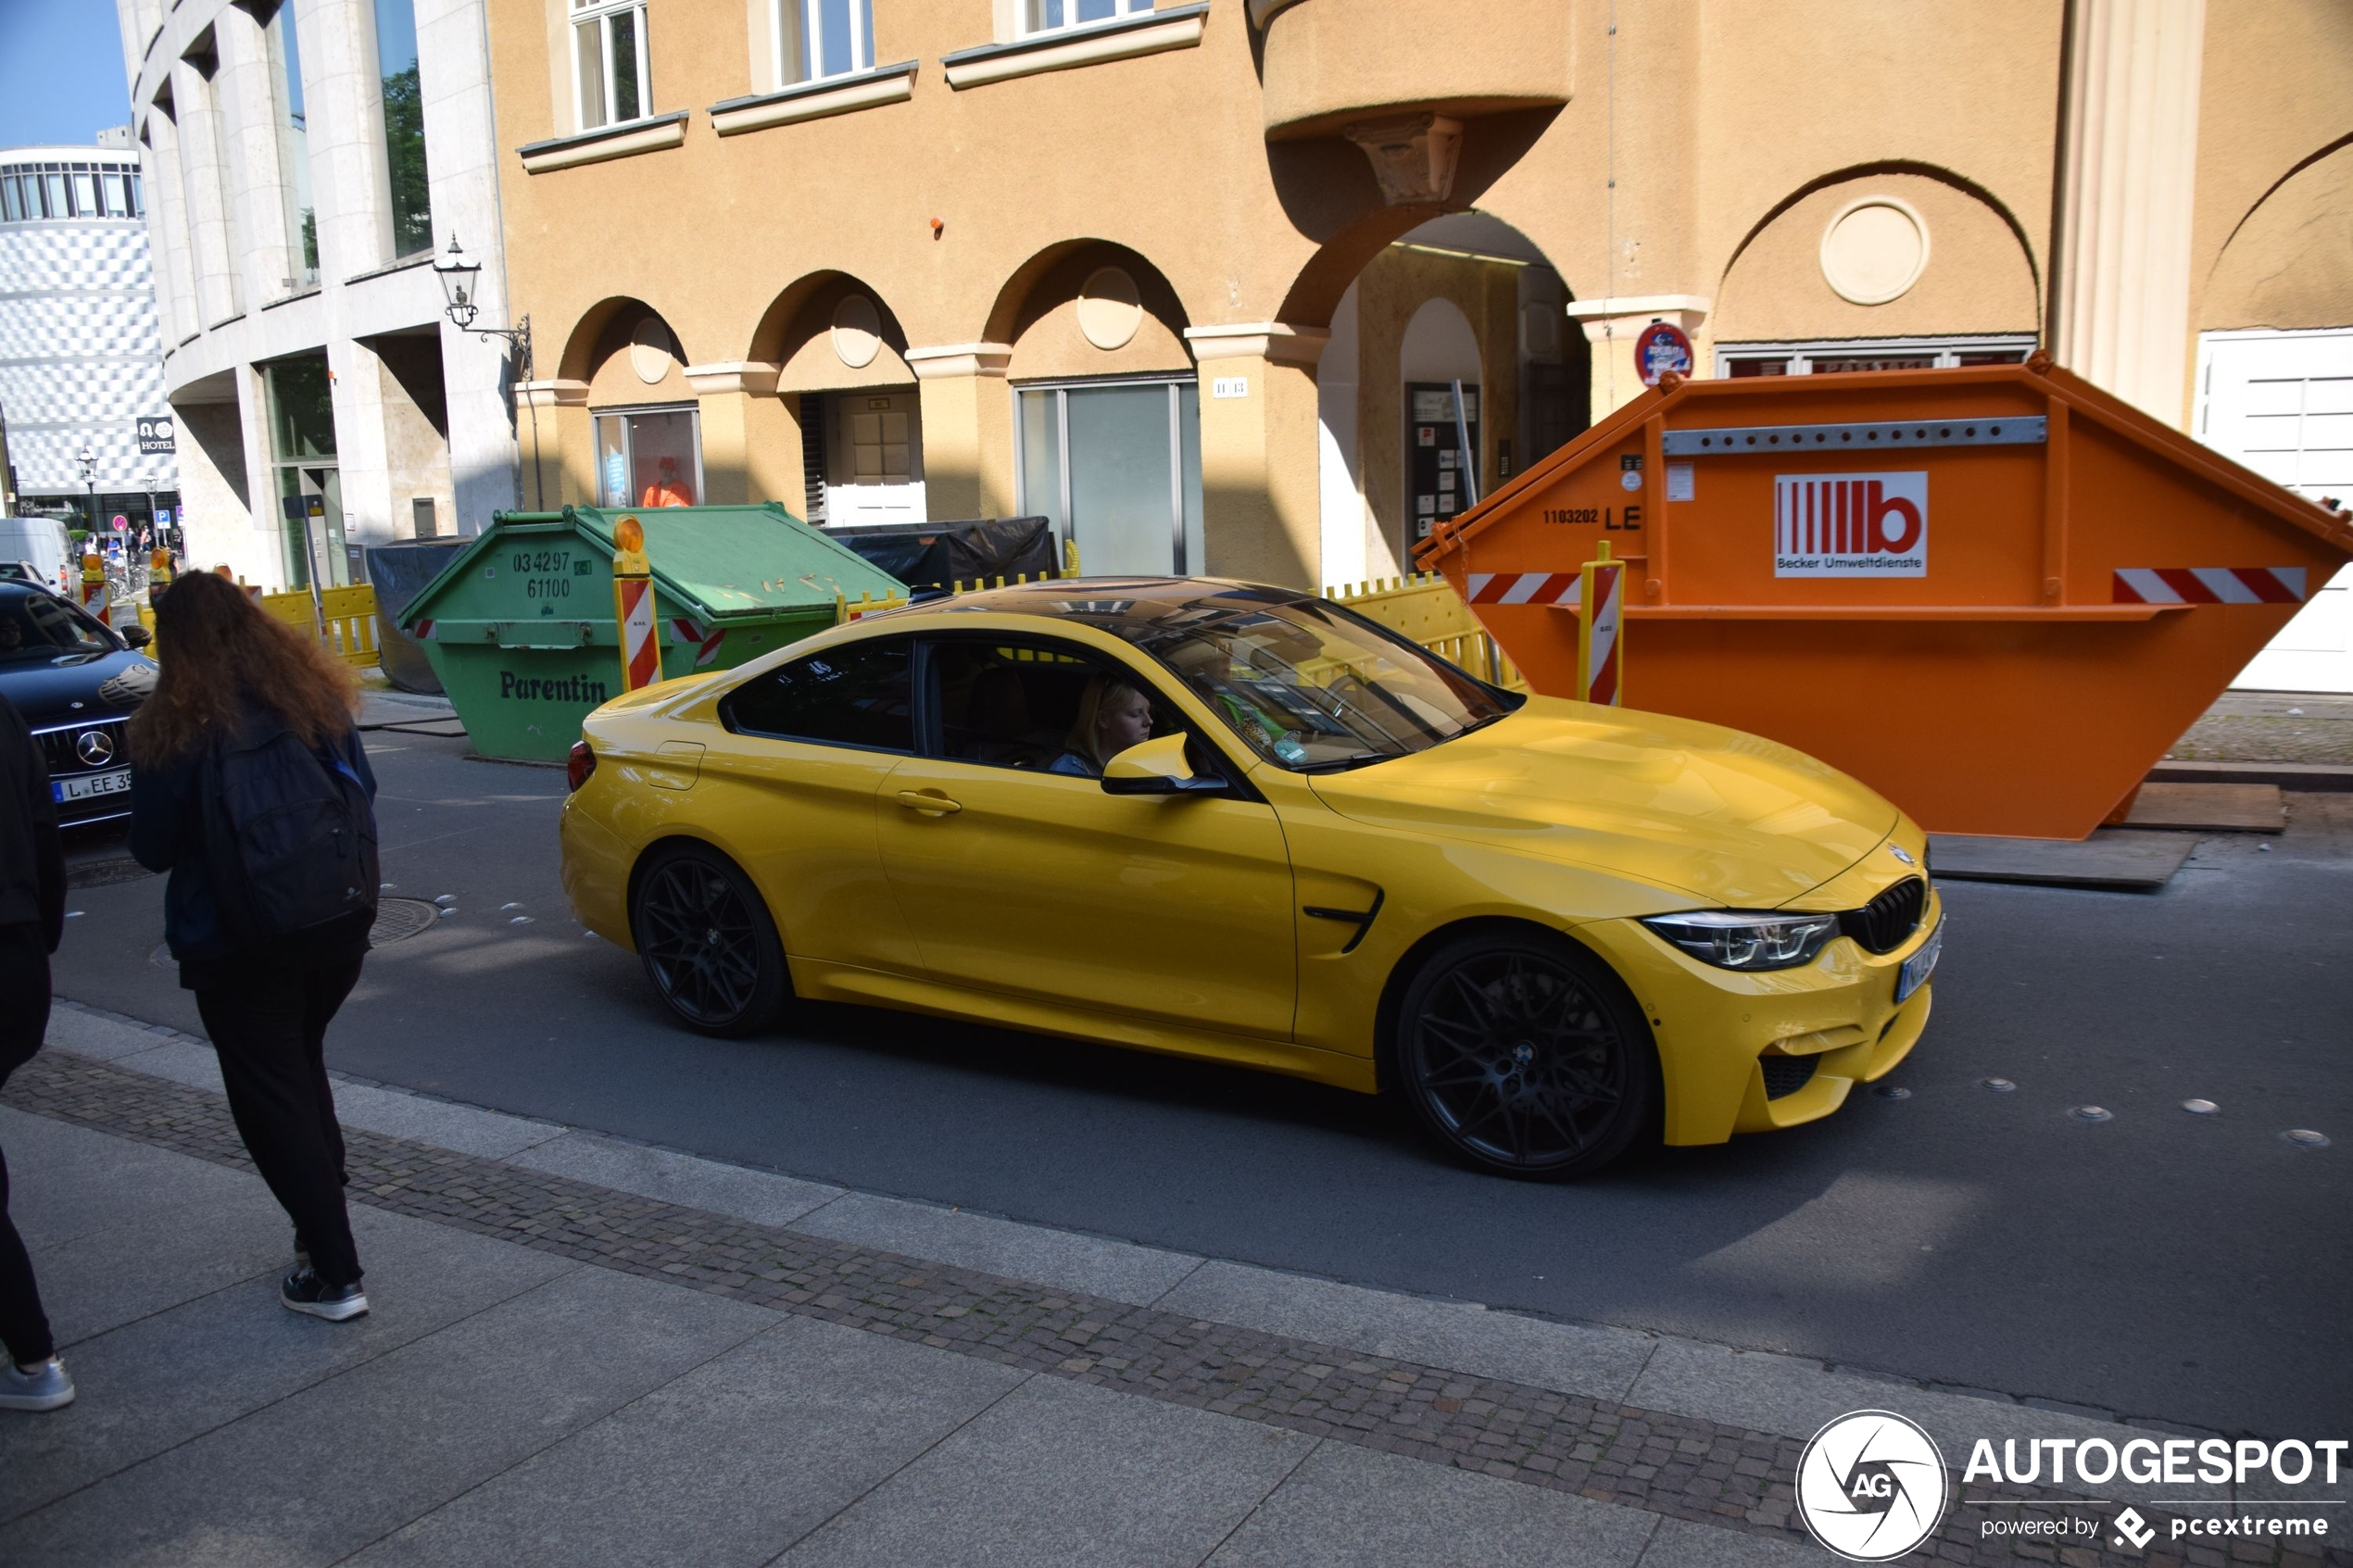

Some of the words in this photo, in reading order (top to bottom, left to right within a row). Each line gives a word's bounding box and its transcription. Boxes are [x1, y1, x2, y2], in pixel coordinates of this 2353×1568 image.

[1217, 383, 1226, 394] 11
[142, 441, 175, 450] HOTEL
[158, 511, 167, 521] P
[1543, 509, 1598, 524] 1103202
[1605, 506, 1641, 531] LE
[1777, 558, 1820, 569] Becker
[1825, 557, 1922, 569] Umweltdienste
[527, 578, 570, 598] 61100
[500, 671, 609, 704] Parentin
[69, 784, 81, 797] L
[91, 777, 114, 794] EE
